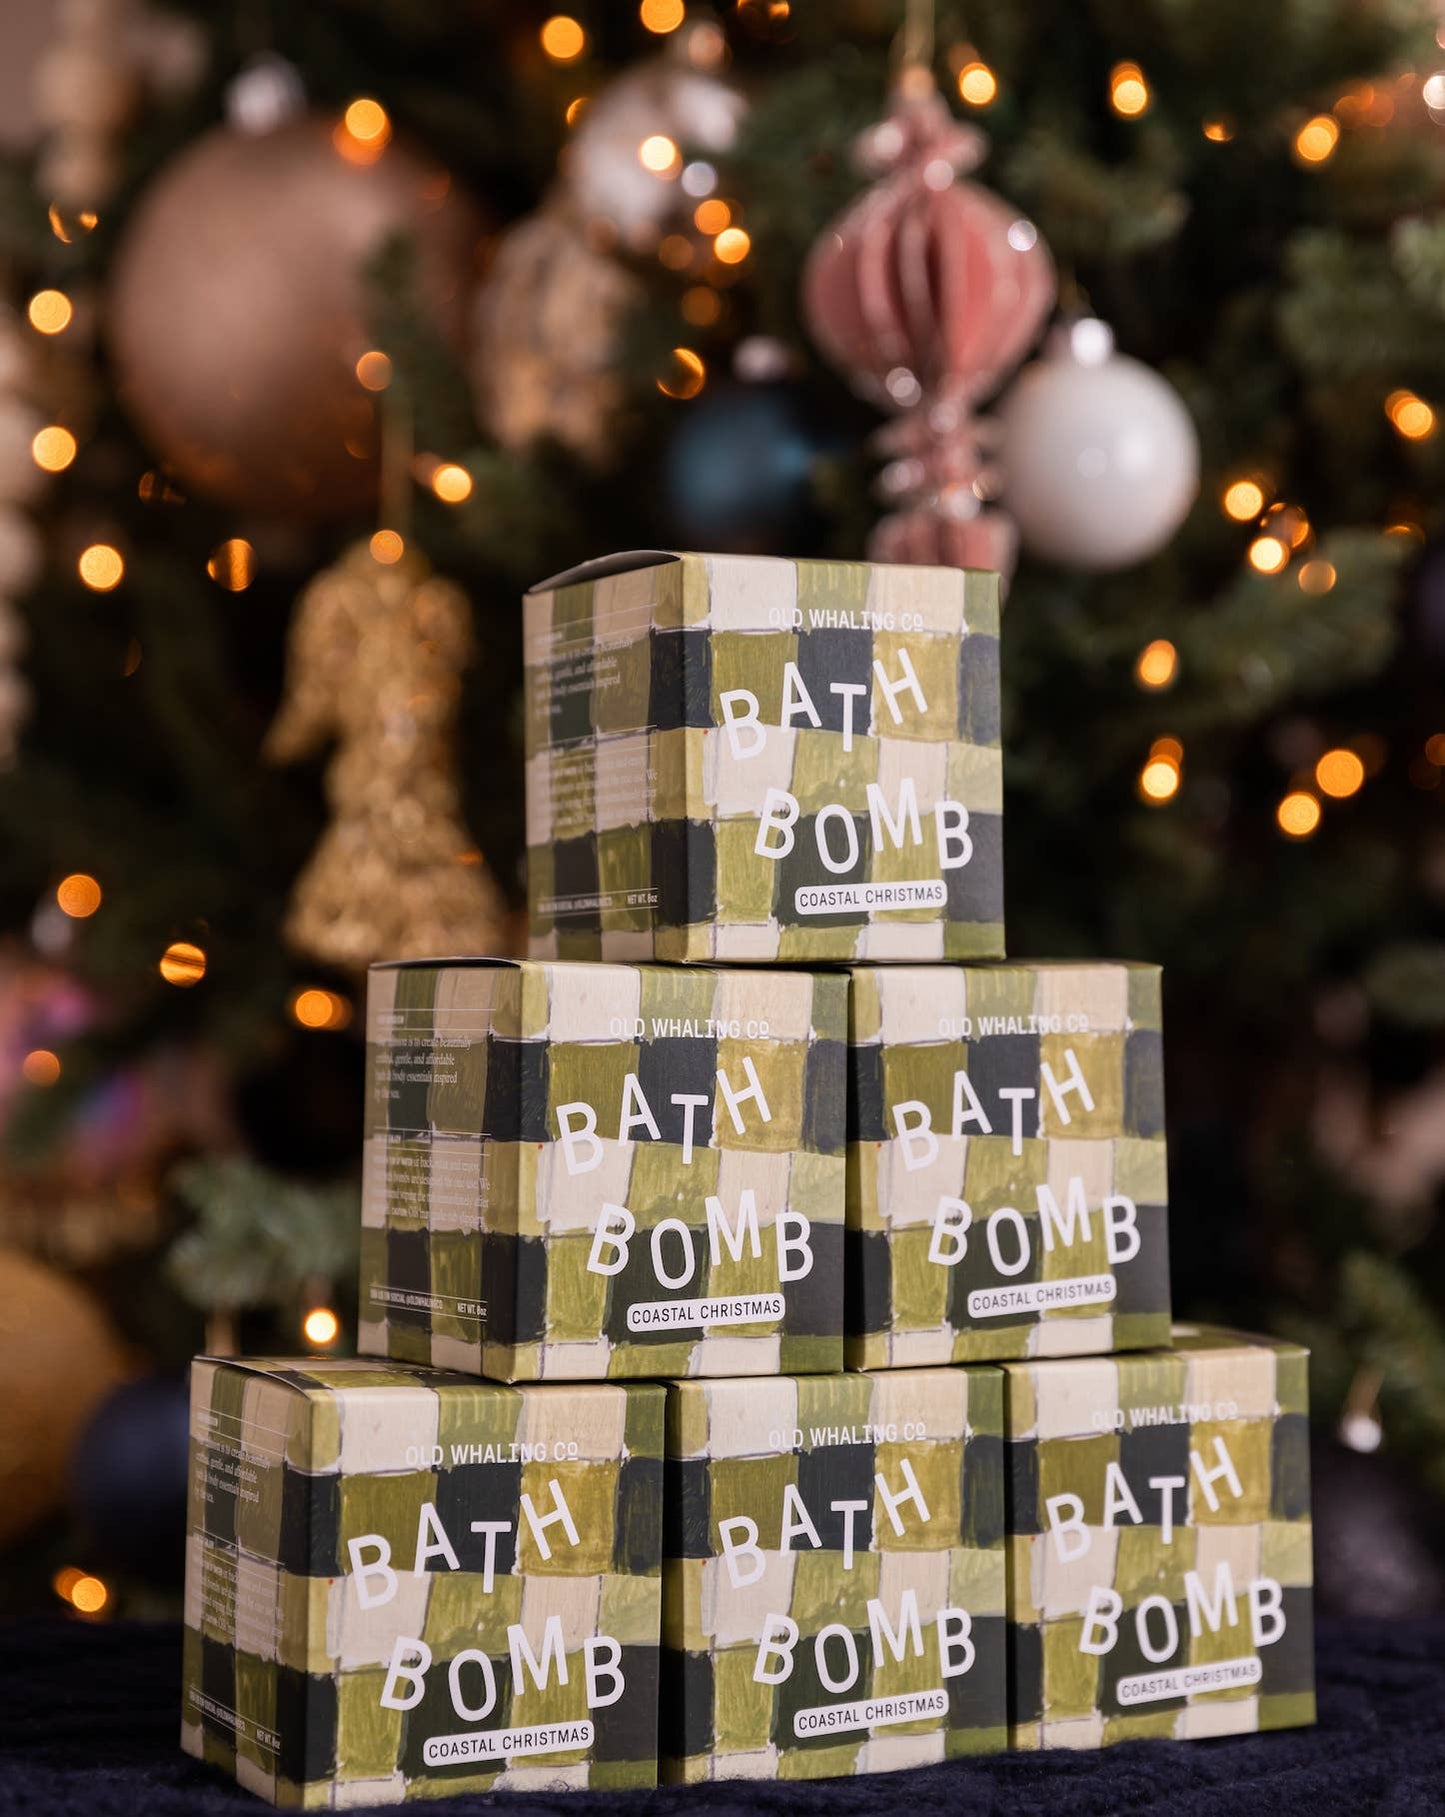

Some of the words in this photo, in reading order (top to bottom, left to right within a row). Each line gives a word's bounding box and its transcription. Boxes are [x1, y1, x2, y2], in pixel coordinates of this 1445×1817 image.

[768, 607, 804, 627] OLD
[809, 608, 896, 631] WHALING
[719, 647, 928, 761] BATH
[754, 778, 974, 874] BOMB
[799, 891, 861, 908] COASTAL
[865, 886, 943, 904] CHRISTMAS
[609, 1017, 645, 1037] OLD
[651, 1017, 741, 1039] WHALING
[937, 1017, 972, 1036] OLD
[977, 1014, 1062, 1035] WHALING
[556, 1056, 772, 1176] BATH
[892, 1047, 1095, 1172] BATH
[586, 1189, 815, 1290] BOMB
[928, 1176, 1141, 1277] BOMB
[631, 1306, 696, 1325] COASTAL
[699, 1299, 781, 1321] CHRISTMAS
[972, 1293, 1031, 1311] COASTAL
[1035, 1281, 1112, 1303] CHRISTMAS
[768, 1427, 805, 1448] OLD
[810, 1423, 898, 1446] WHALING
[1130, 1402, 1212, 1427] WHALING
[405, 1444, 444, 1465] OLD
[450, 1442, 546, 1465] WHALING
[718, 1458, 932, 1590] BATH
[1045, 1435, 1244, 1564] BATH
[347, 1478, 581, 1611] BATH
[753, 1589, 976, 1695] BOMB
[1079, 1561, 1287, 1664] BOMB
[380, 1615, 626, 1722] BOMB
[1121, 1678, 1179, 1698] COASTAL
[1183, 1663, 1257, 1687] CHRISTMAS
[428, 1739, 497, 1759] COASTAL
[502, 1726, 590, 1751] CHRISTMAS
[798, 1709, 861, 1732] COASTAL
[865, 1695, 945, 1720] CHRISTMAS
